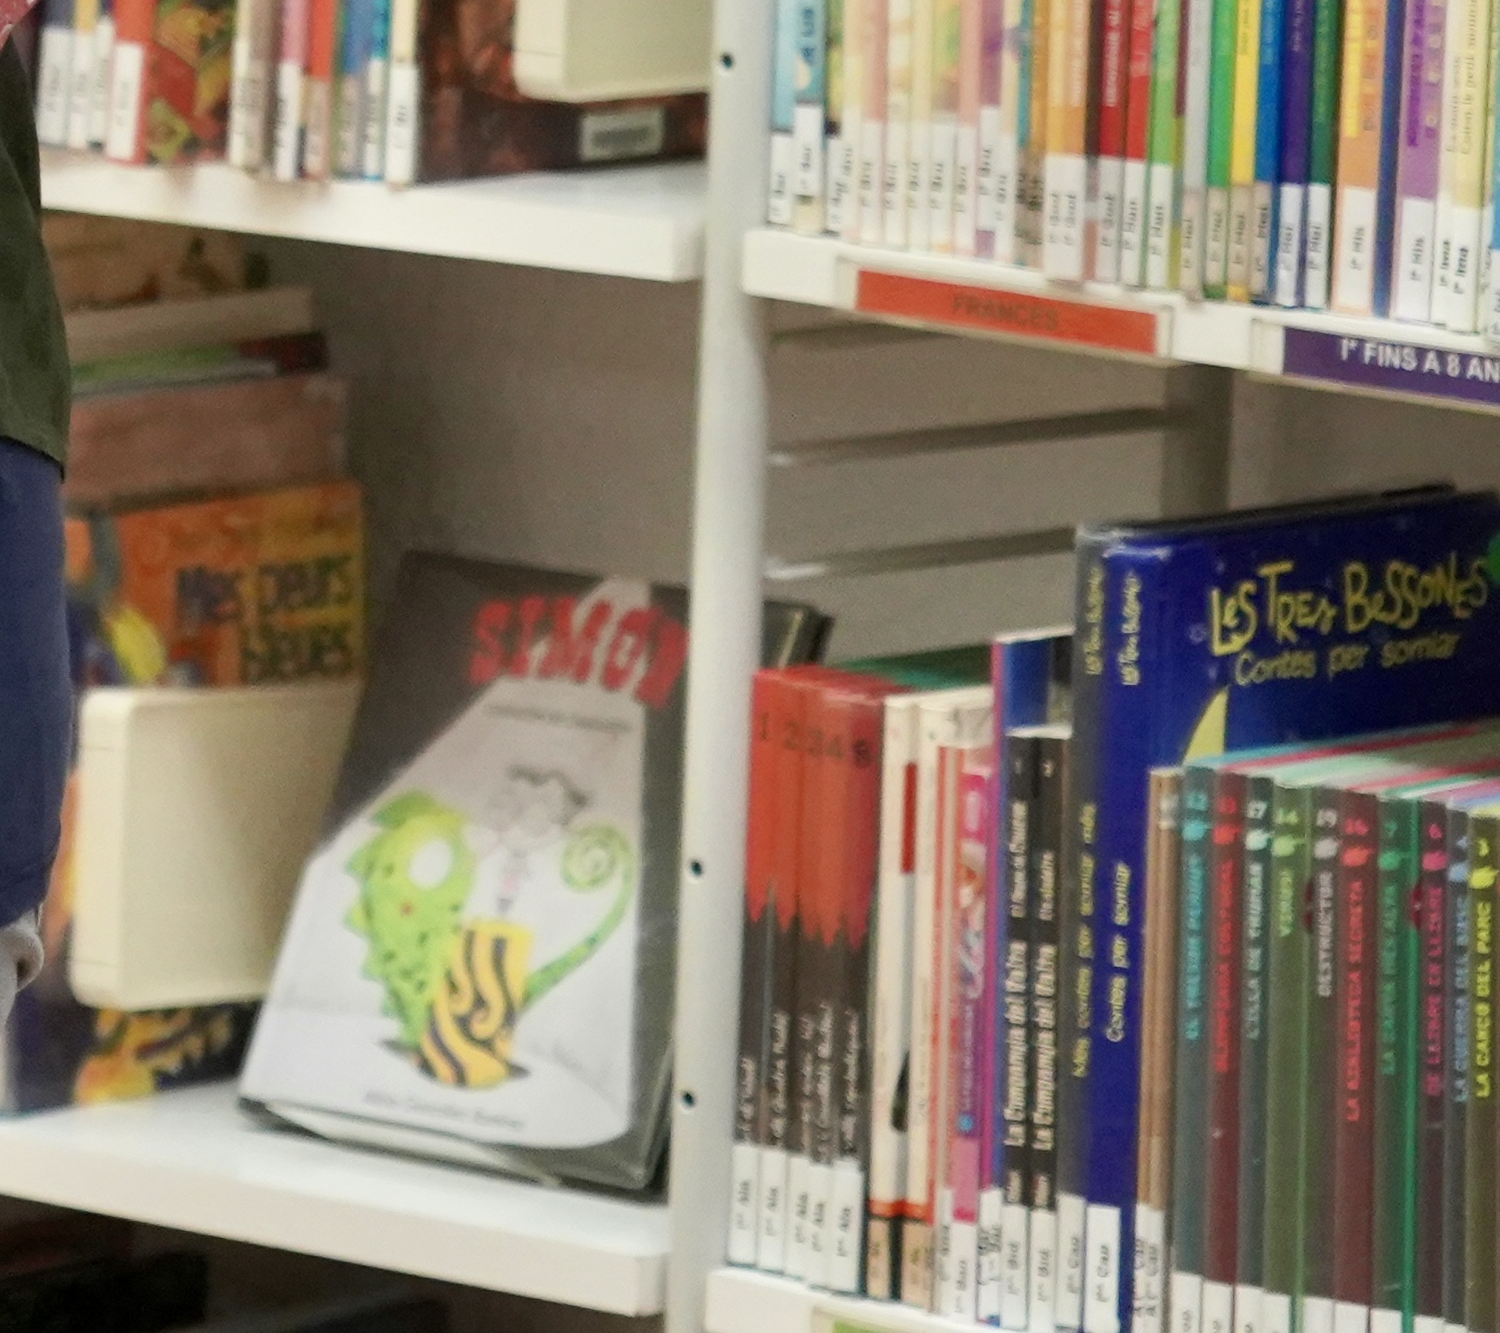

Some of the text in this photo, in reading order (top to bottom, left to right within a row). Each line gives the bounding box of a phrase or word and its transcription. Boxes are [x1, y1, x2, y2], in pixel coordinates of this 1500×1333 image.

[1363, 341, 1419, 373] FINS
[1422, 349, 1442, 376] A
[1446, 351, 1462, 378] 8
[1466, 354, 1500, 384] AN
[1233, 632, 1461, 686] Contes per somiar
[1106, 862, 1132, 1042] Contes per somiar
[1477, 901, 1493, 953] PARC
